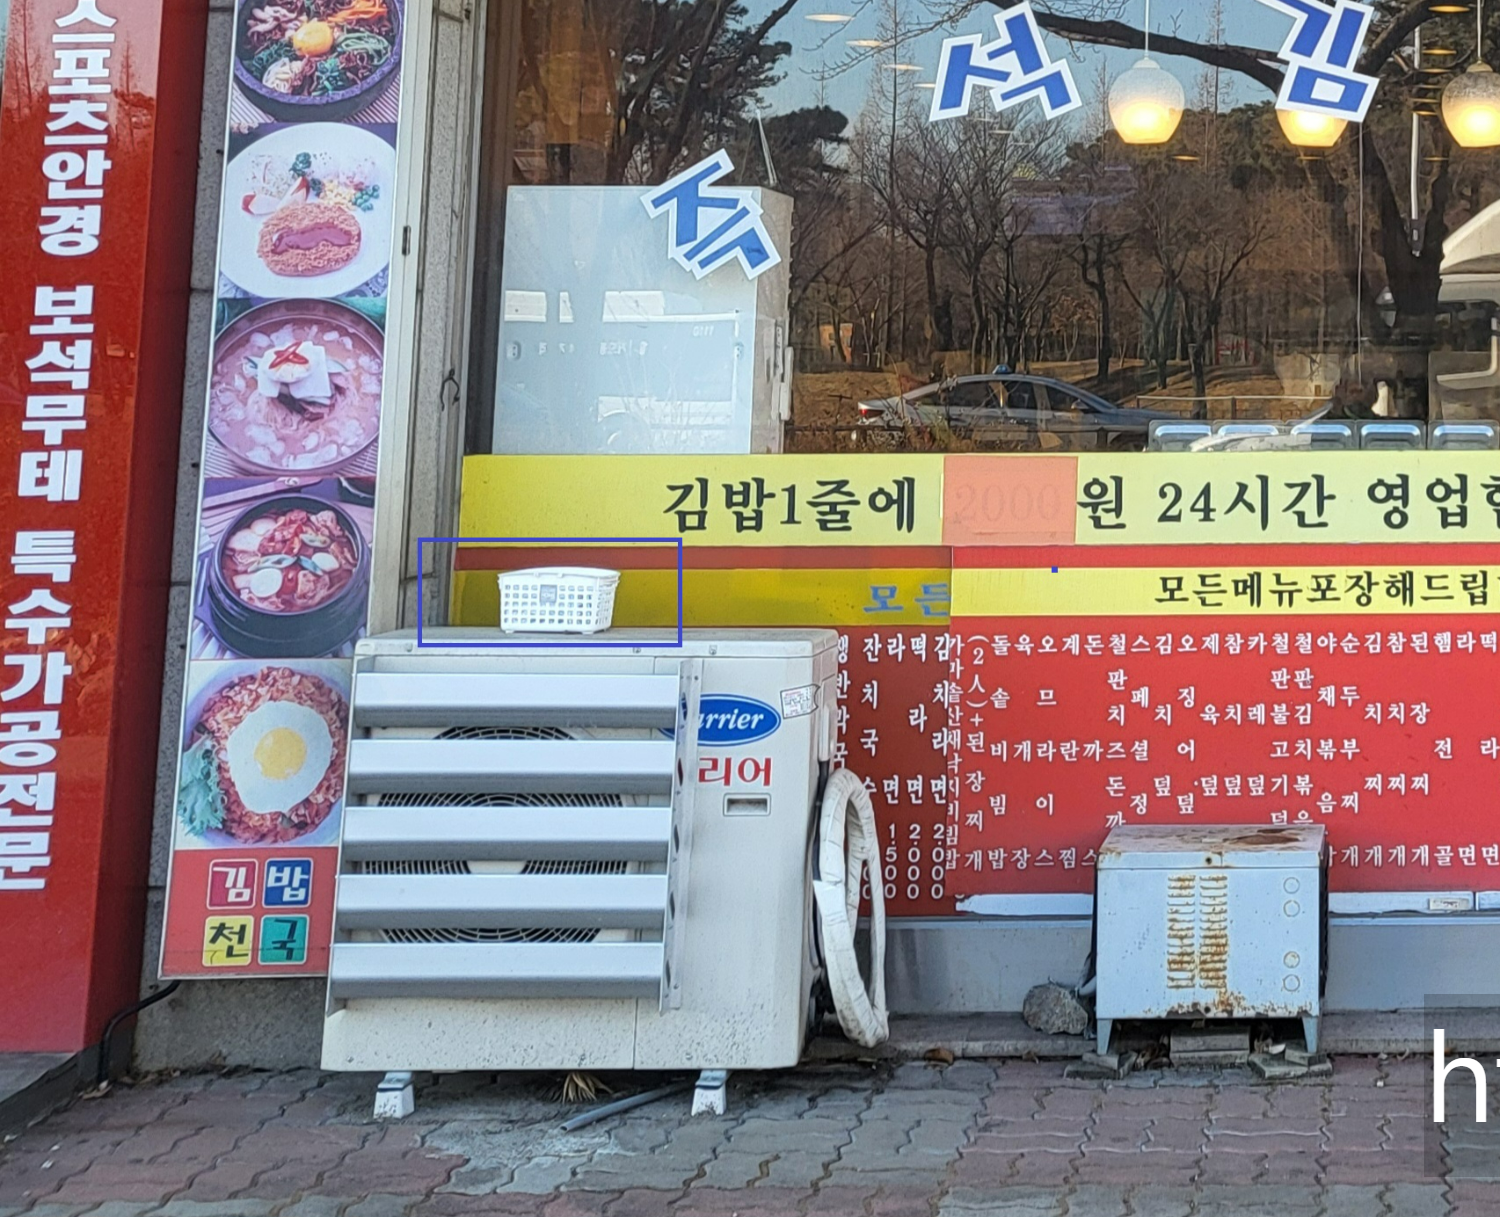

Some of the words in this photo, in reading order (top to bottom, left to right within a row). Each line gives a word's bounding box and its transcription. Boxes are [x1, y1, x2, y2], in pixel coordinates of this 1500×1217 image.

[18, 285, 95, 502] 보석무테
[663, 476, 916, 534] 김밥1줄에
[1077, 474, 1127, 531] 원
[1157, 473, 1337, 531] 24시간
[0, 530, 77, 891] 특수가공전문
[698, 757, 771, 786] 리어
[212, 866, 309, 903] 김밥
[208, 917, 299, 961] 천국
